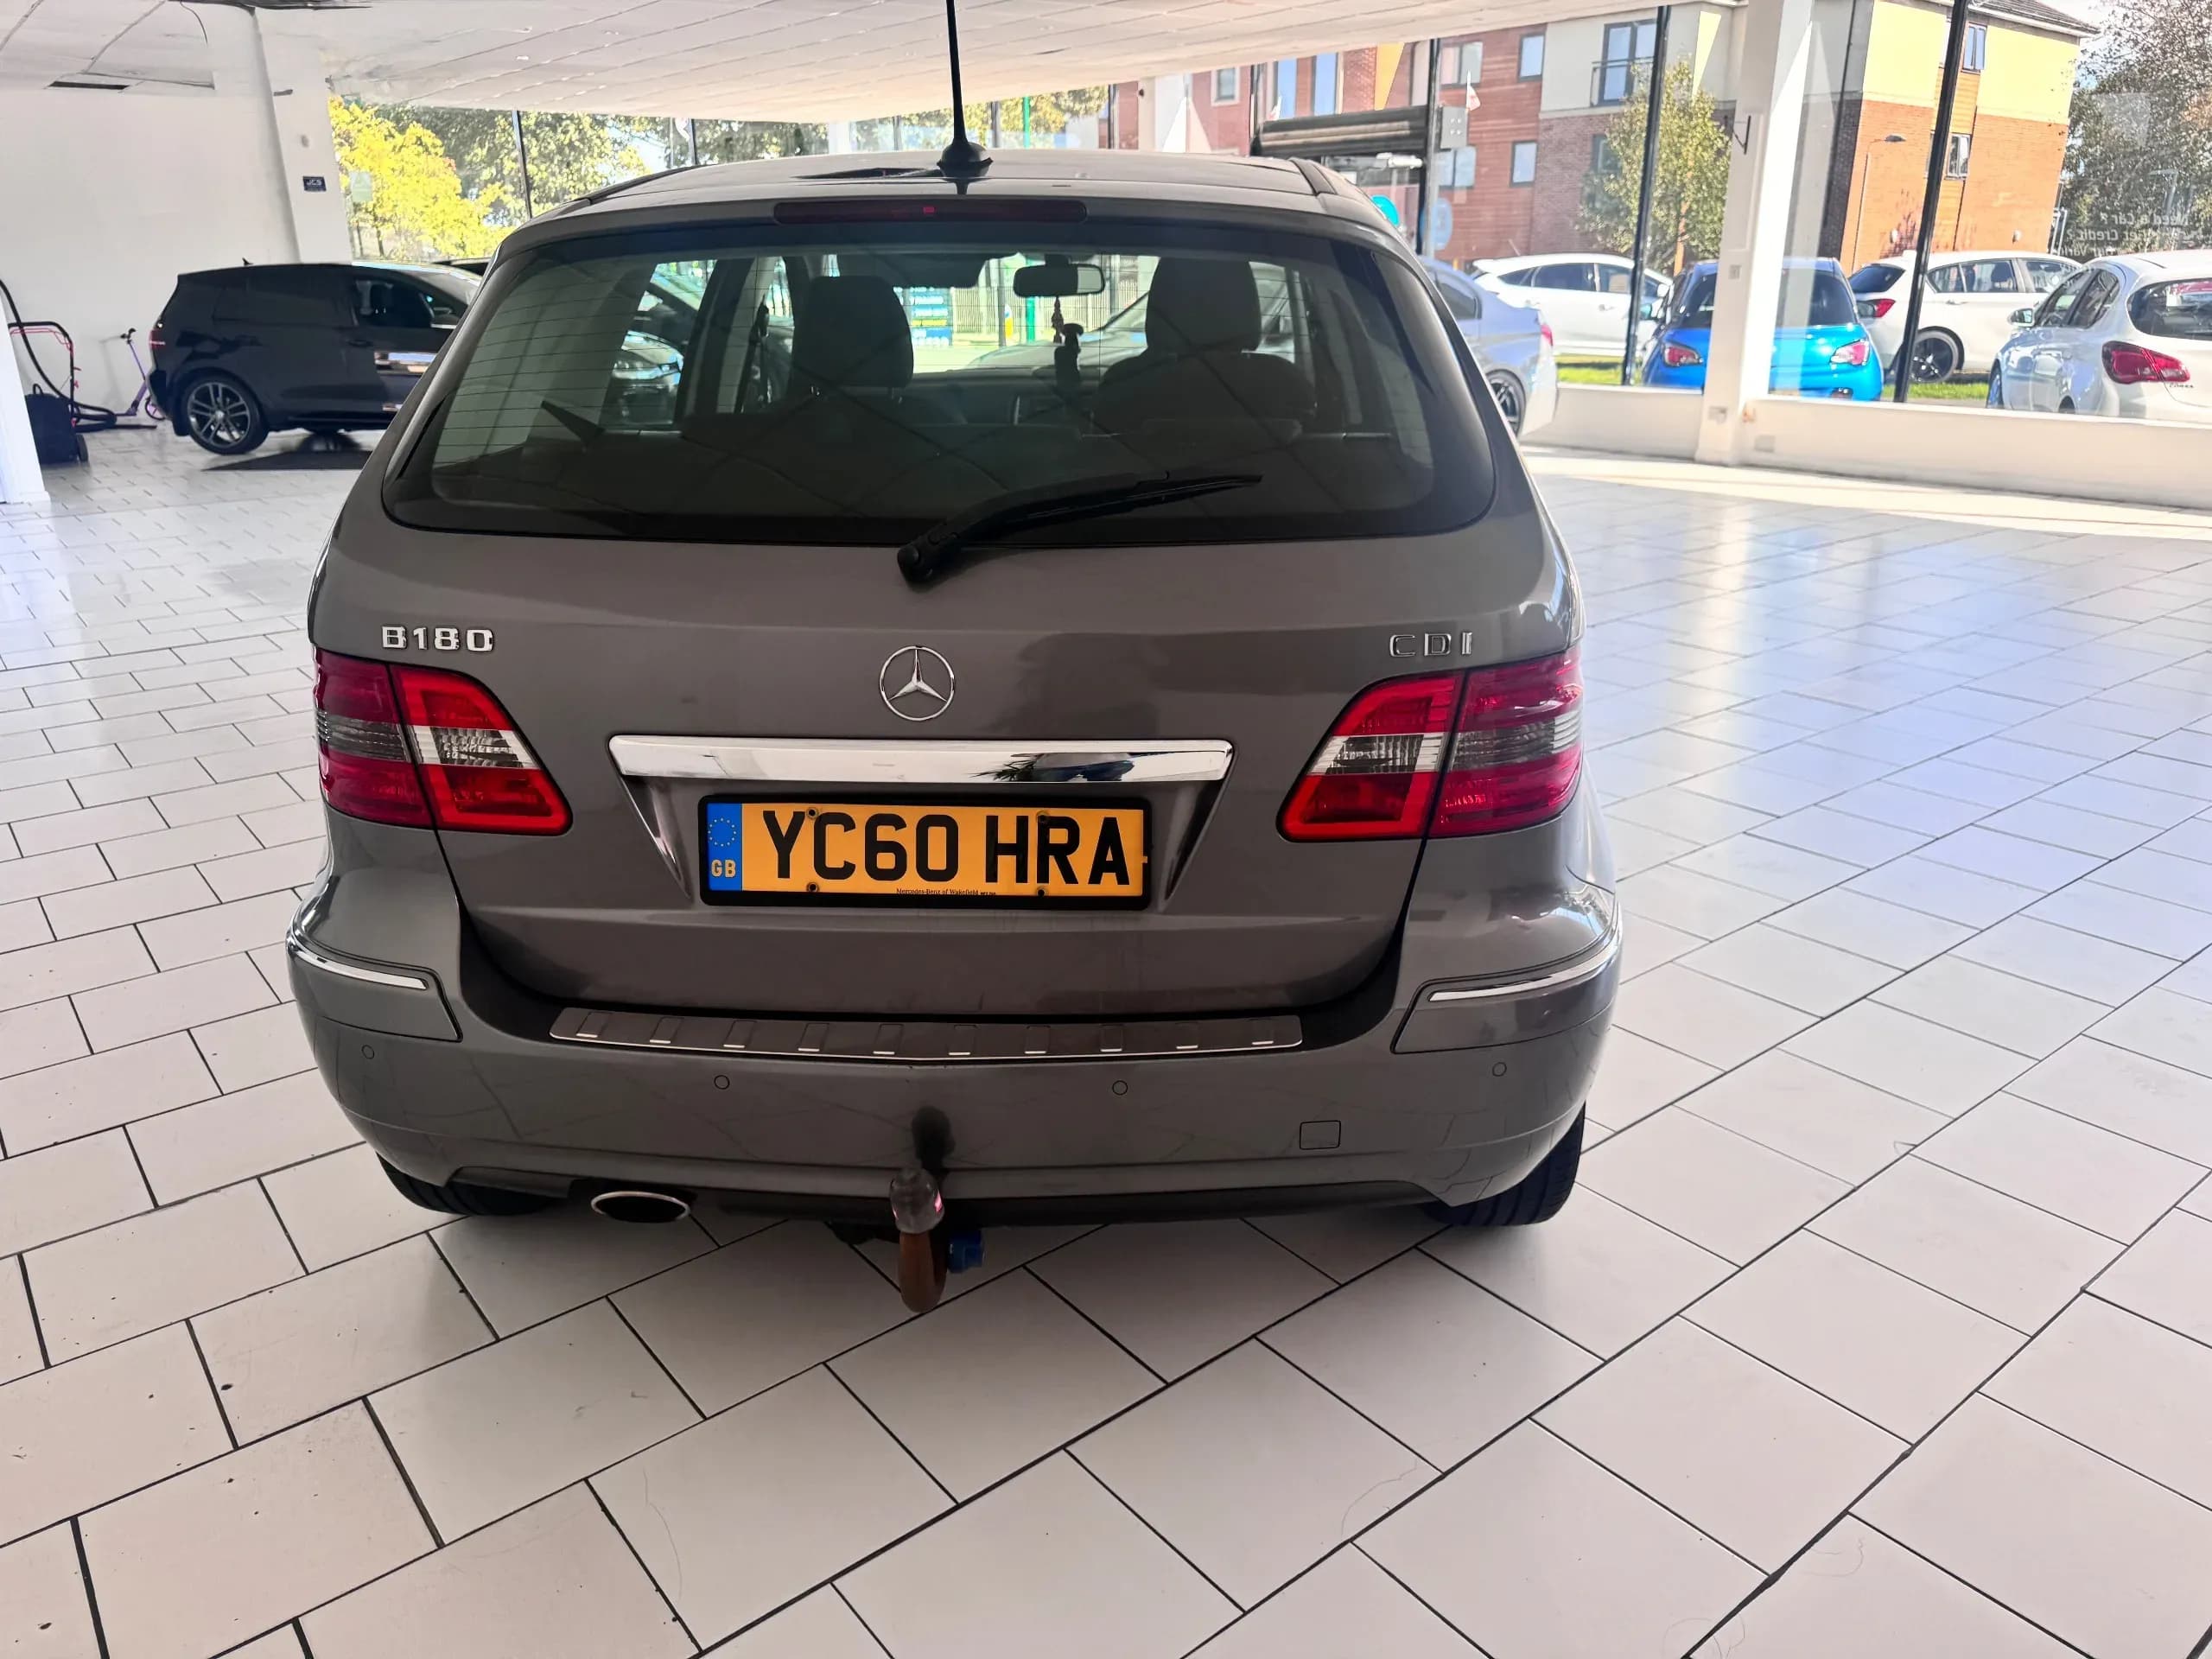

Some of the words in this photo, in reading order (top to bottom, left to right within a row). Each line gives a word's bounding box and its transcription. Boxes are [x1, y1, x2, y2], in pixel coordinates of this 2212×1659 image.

[382, 626, 493, 652] B180
[1389, 632, 1472, 657] CDI
[763, 810, 959, 882] YC60
[985, 815, 1130, 886] HRA
[711, 859, 736, 878] GB
